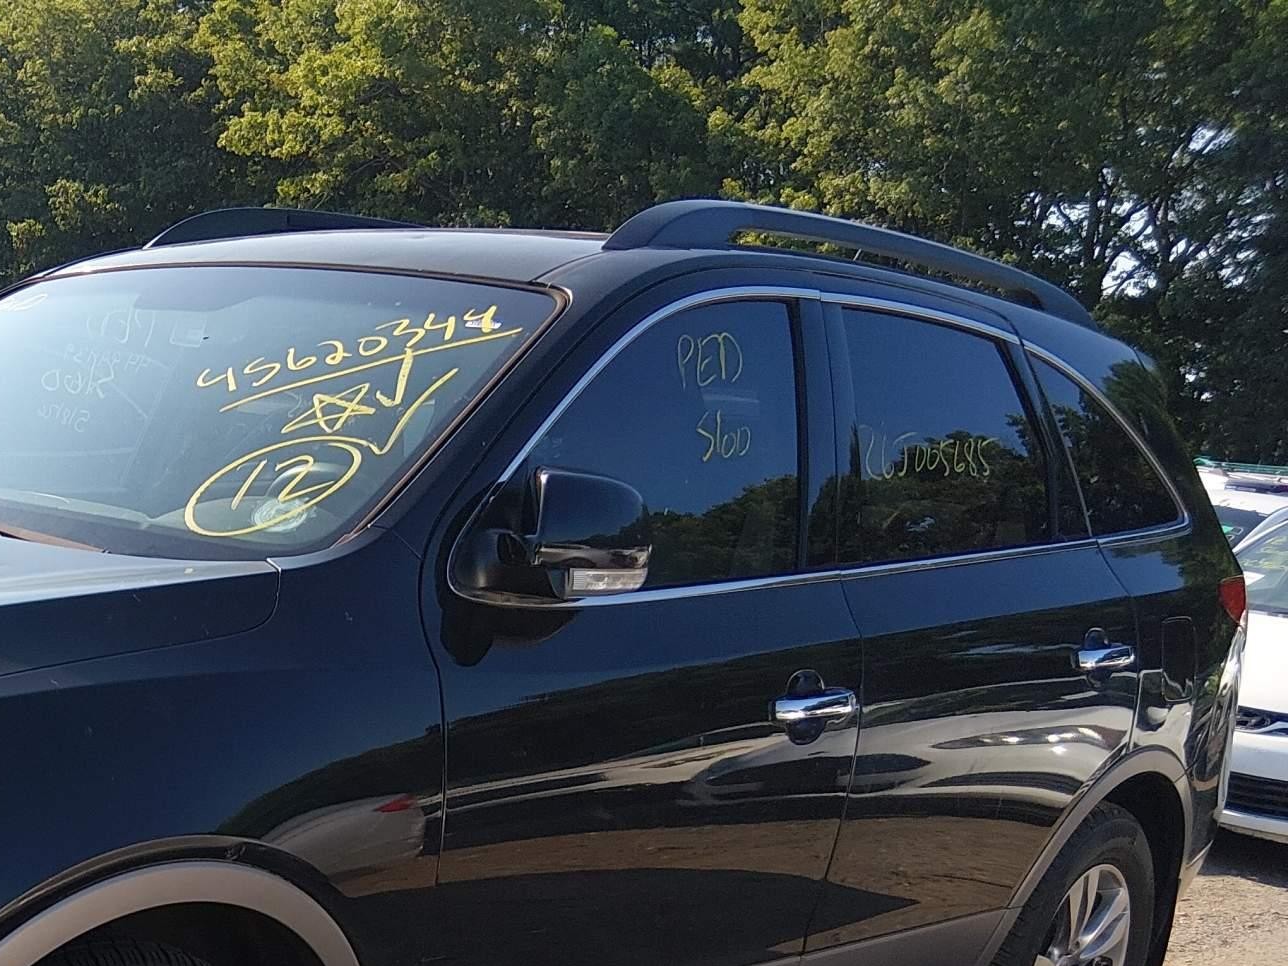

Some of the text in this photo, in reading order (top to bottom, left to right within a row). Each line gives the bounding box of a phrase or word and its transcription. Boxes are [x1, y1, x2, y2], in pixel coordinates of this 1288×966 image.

[196, 305, 498, 392] 45620344
[677, 332, 744, 391] PED
[859, 420, 1000, 480] 26J005685
